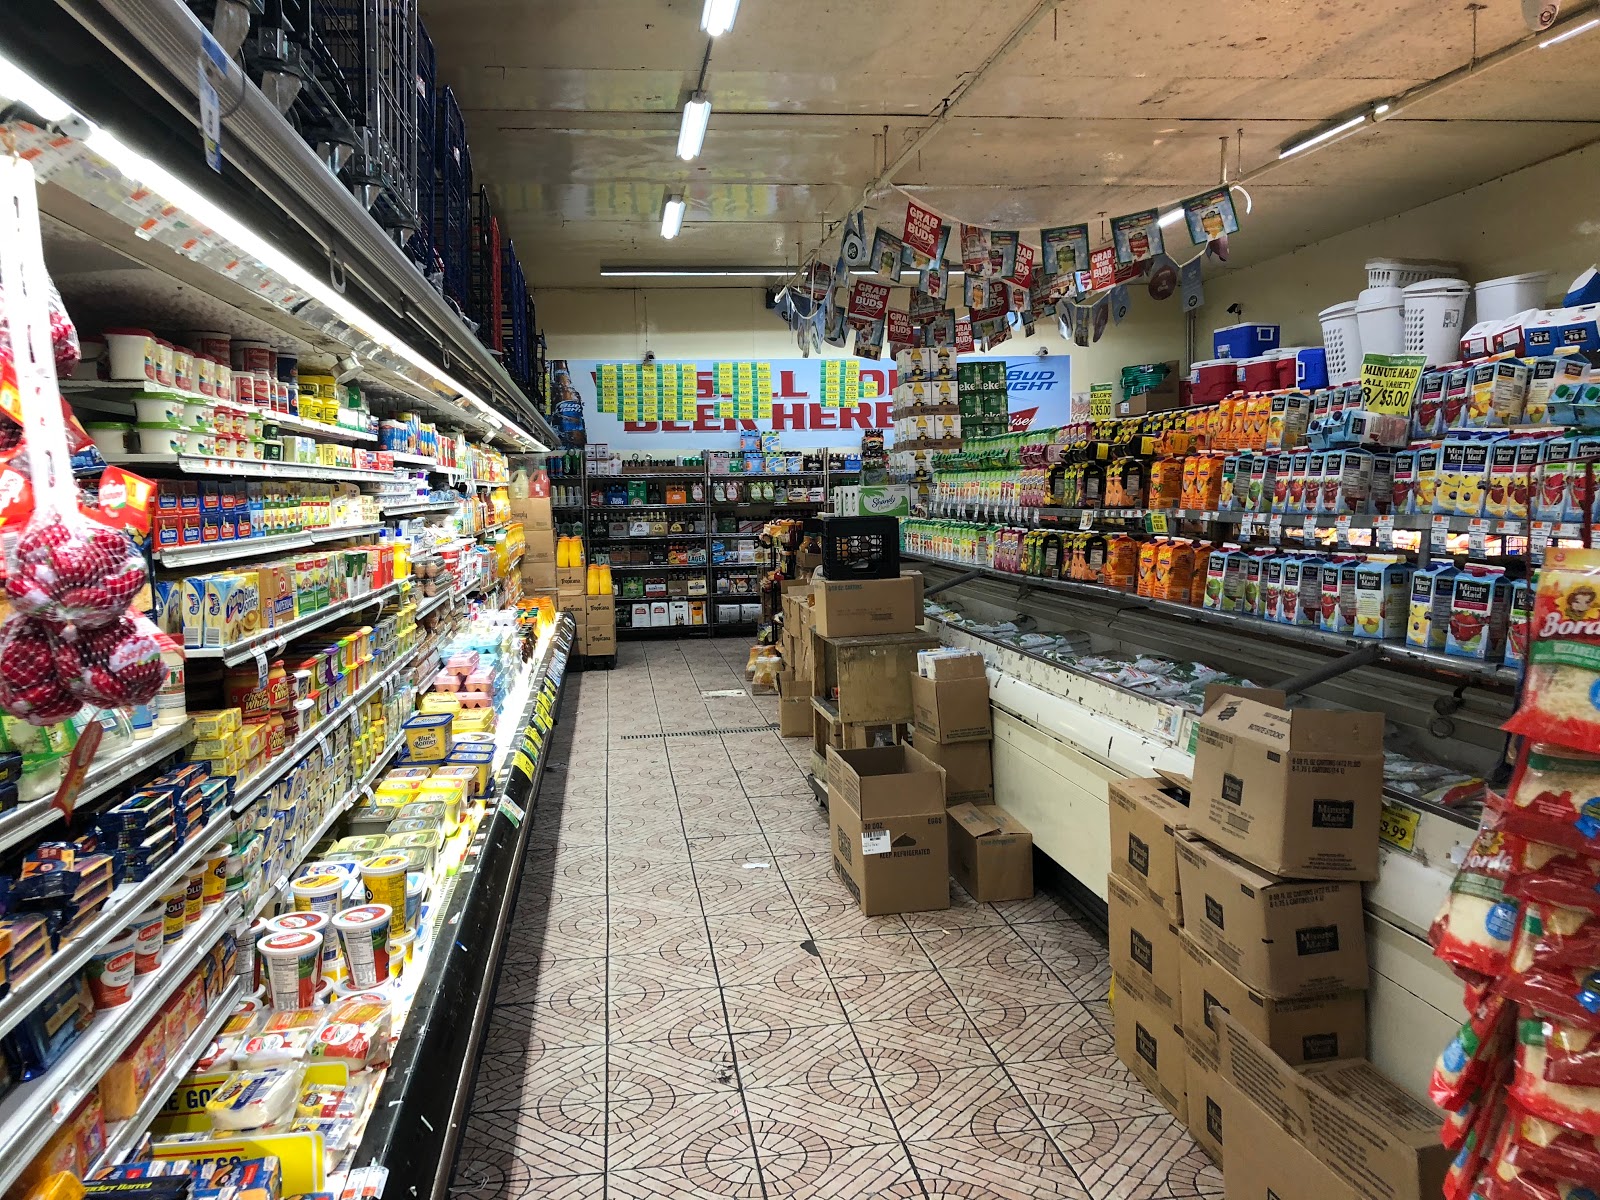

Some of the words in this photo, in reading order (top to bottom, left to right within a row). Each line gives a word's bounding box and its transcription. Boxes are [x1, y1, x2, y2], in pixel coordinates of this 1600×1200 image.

[909, 206, 939, 229] GRAB
[913, 218, 931, 233] SOME
[907, 221, 935, 245] BUDS
[1091, 249, 1112, 264] GRAB
[1096, 259, 1110, 268] SOME
[1093, 264, 1113, 278] BUDS
[857, 283, 888, 296] GRAB
[861, 292, 881, 300] SOME
[855, 295, 884, 309] BUDS
[889, 324, 911, 335] BUDS
[955, 323, 972, 333] GRAB
[955, 335, 973, 344] BUDS
[1006, 370, 1056, 381] BUD
[1363, 364, 1398, 378] MINUTE
[1397, 368, 1418, 379] MAID
[1476, 368, 1493, 376] Minute
[1006, 381, 1059, 391] IGHT
[1363, 377, 1384, 388] ALL
[1385, 380, 1414, 390] VARIETY
[771, 401, 898, 431] HERE
[1447, 446, 1462, 454] Min
[1466, 447, 1486, 455] Minute
[1496, 448, 1515, 456] Minute
[1519, 446, 1538, 454] Minute
[1551, 445, 1569, 453] Minute
[1450, 453, 1462, 461] Ma
[1359, 573, 1380, 581] Minute
[1361, 579, 1376, 587] Maid
[1415, 578, 1431, 586] Minute
[1416, 584, 1428, 592] Maid
[1459, 583, 1487, 593] Minute
[1461, 590, 1482, 599] Maid
[274, 598, 293, 613] IMPERIAL
[590, 603, 610, 611] Tropicana
[591, 634, 611, 642] Tropicana
[414, 739, 436, 747] Bonnet
[1317, 805, 1351, 814] Minute
[1321, 813, 1345, 822] Maid
[880, 851, 892, 859] KEEP
[893, 848, 931, 858] REFRIGERATED
